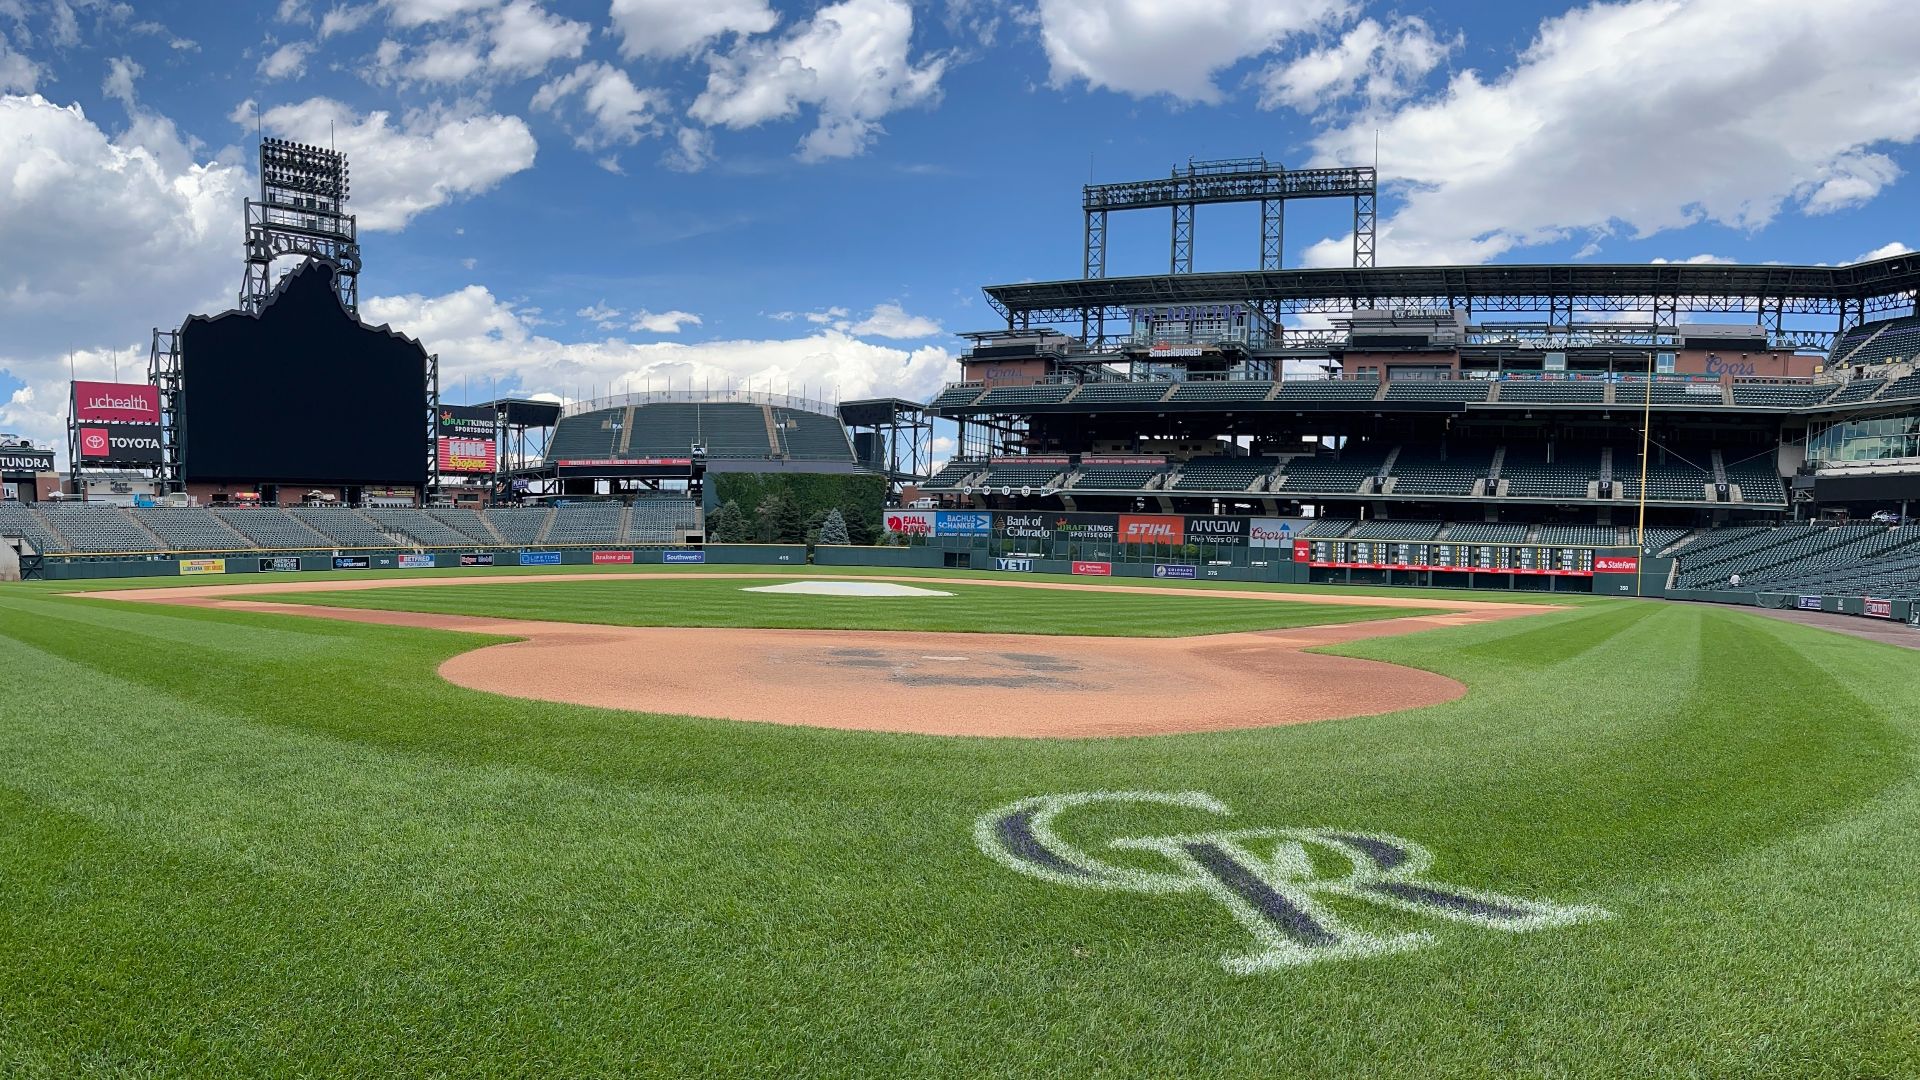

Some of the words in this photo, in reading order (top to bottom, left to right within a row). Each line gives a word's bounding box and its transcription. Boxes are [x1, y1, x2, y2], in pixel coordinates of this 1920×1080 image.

[250, 230, 362, 274] ROCKIES
[1128, 307, 1155, 322] THE
[1168, 304, 1241, 320] ROOFTOP
[1706, 356, 1755, 375] Coors
[89, 394, 148, 410] uchealth
[442, 418, 494, 427] DRAFTKINGS
[455, 426, 493, 434] SPORTSBOOK
[109, 437, 160, 449] TOYOTA
[449, 442, 486, 457] KING
[0, 457, 50, 468] TUNDRA
[1488, 479, 1496, 487] A
[1007, 515, 1030, 526] Bank
[1031, 515, 1043, 526] of
[1007, 526, 1050, 537] Colorado
[1127, 524, 1176, 535] STIHL
[1191, 520, 1240, 533] ARROW
[1251, 527, 1285, 540] Coors
[1000, 560, 1029, 570] YETI
